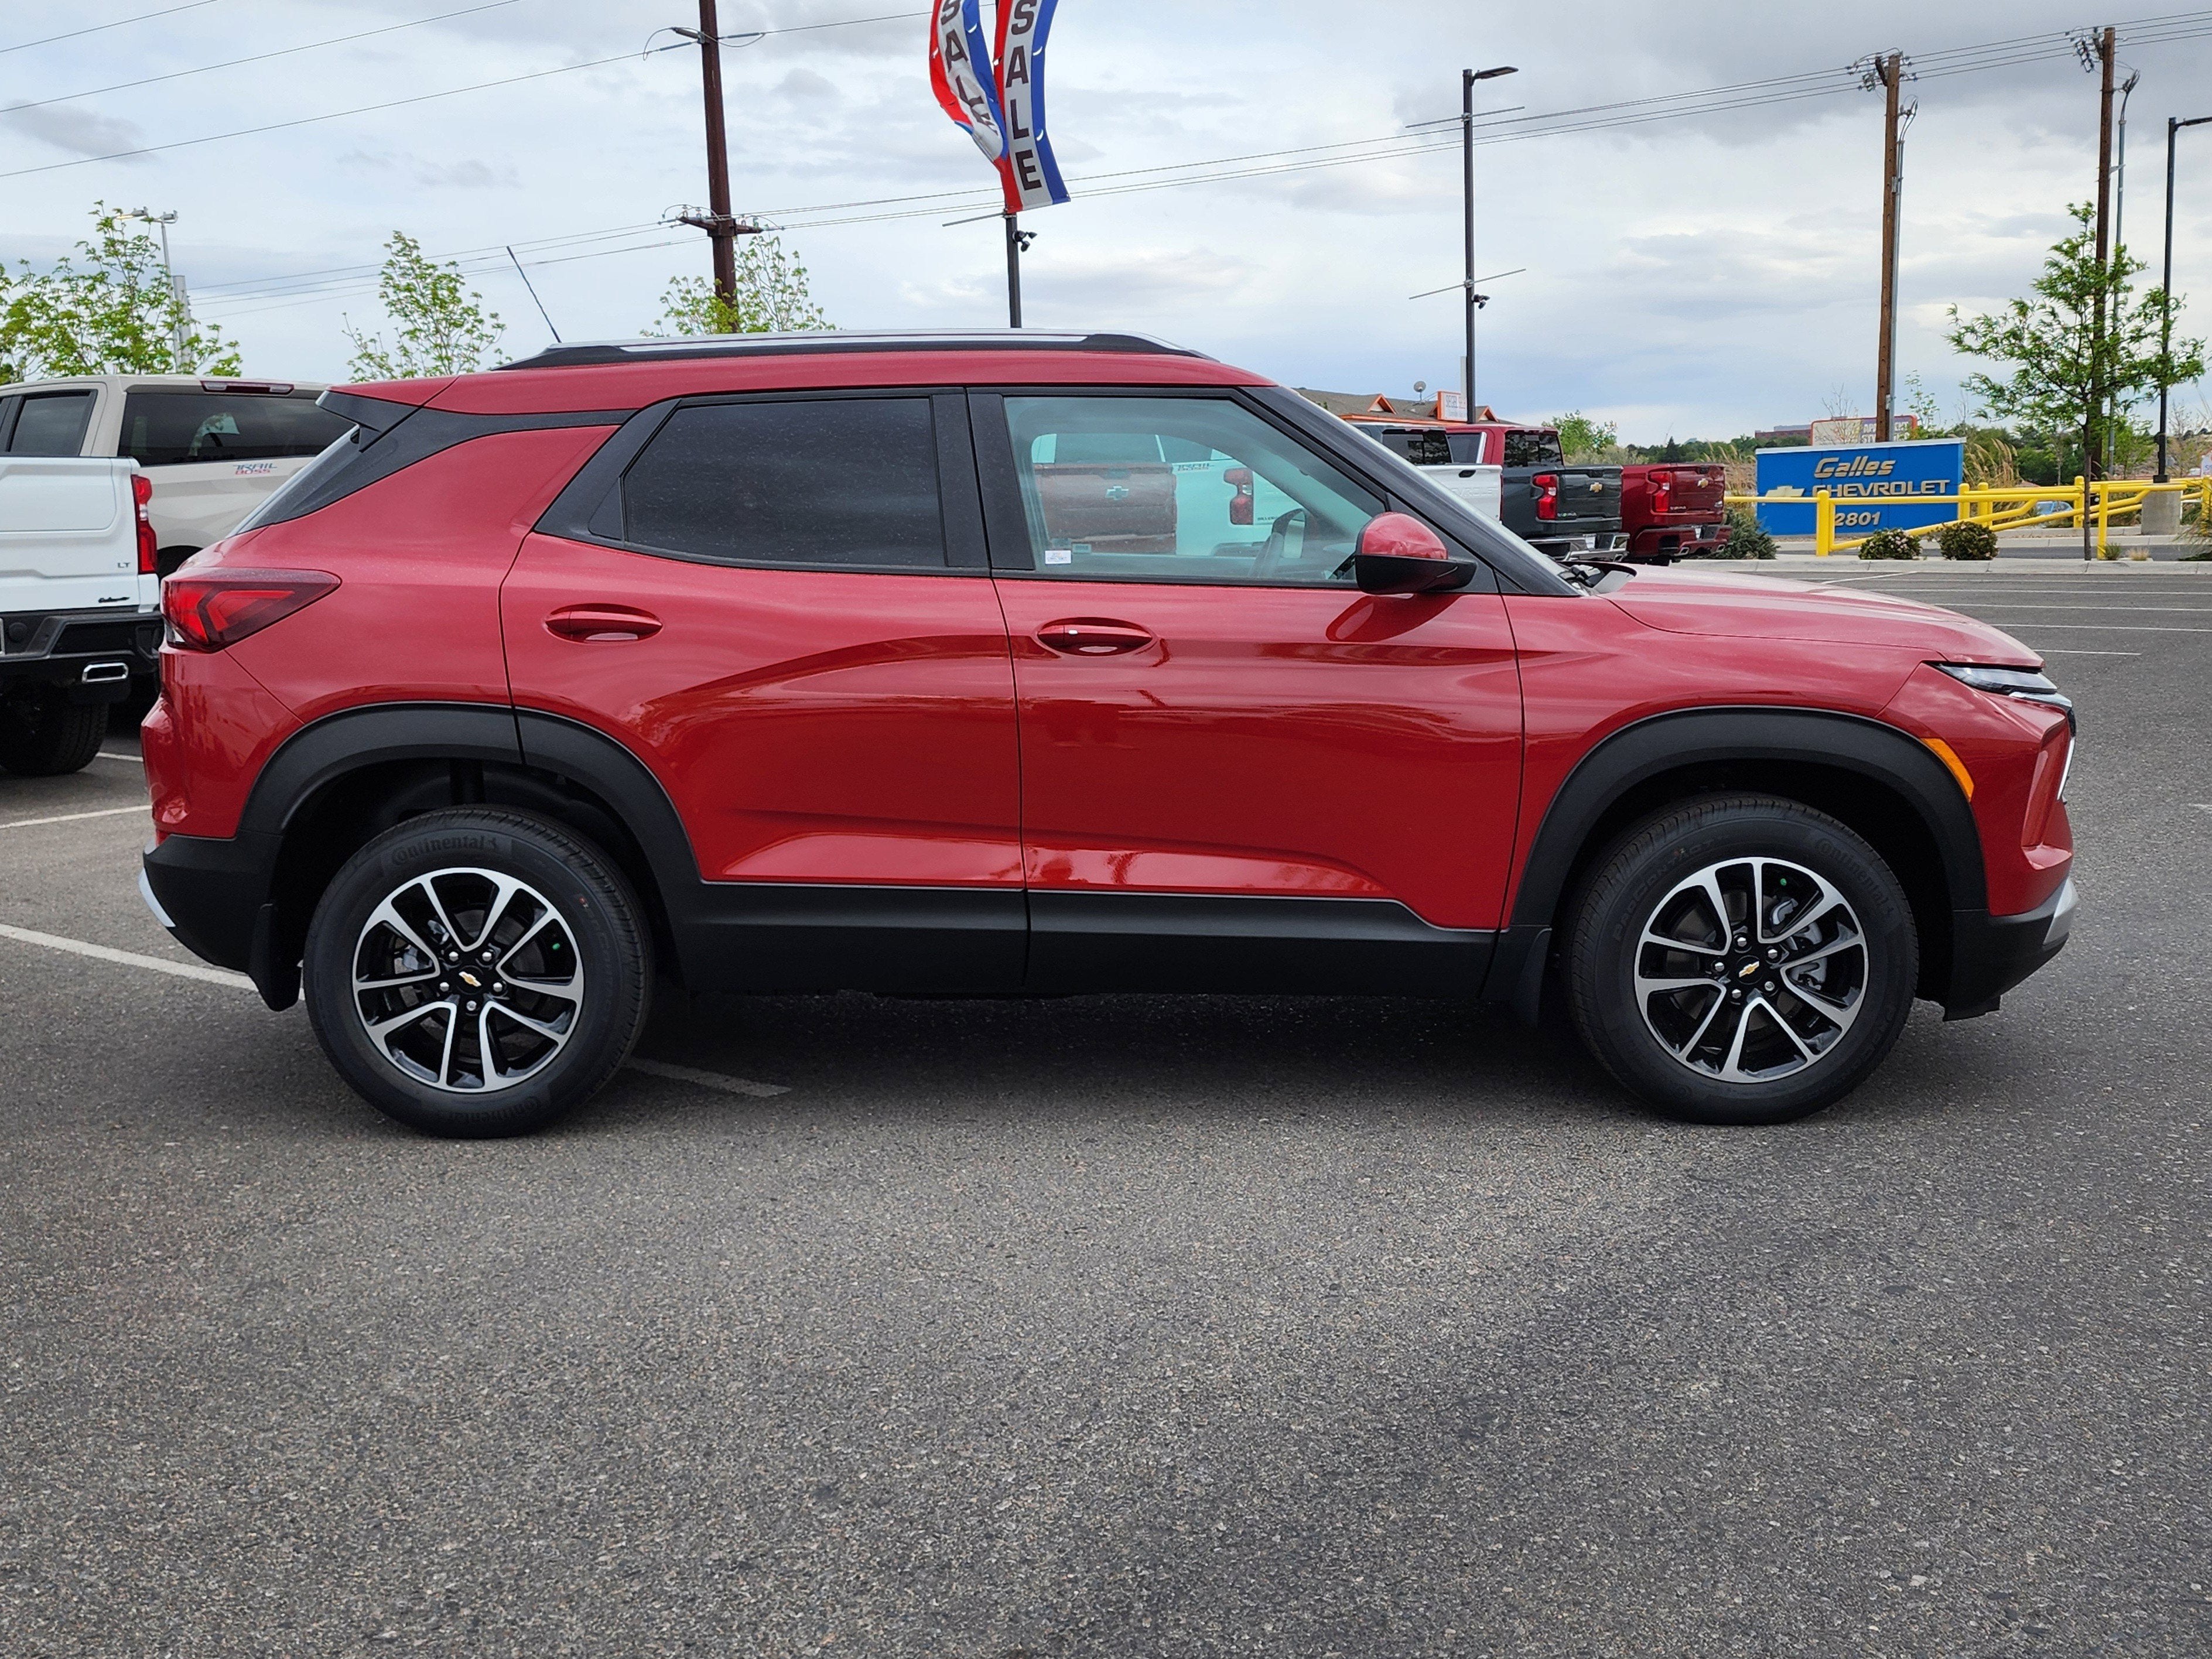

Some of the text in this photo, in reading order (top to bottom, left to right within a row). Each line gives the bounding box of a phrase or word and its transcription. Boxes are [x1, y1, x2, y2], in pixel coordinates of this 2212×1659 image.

[1005, 0, 1042, 191] SALE
[1814, 455, 1896, 478] Galles
[1834, 511, 1881, 526] 2801
[392, 835, 486, 866] Continental
